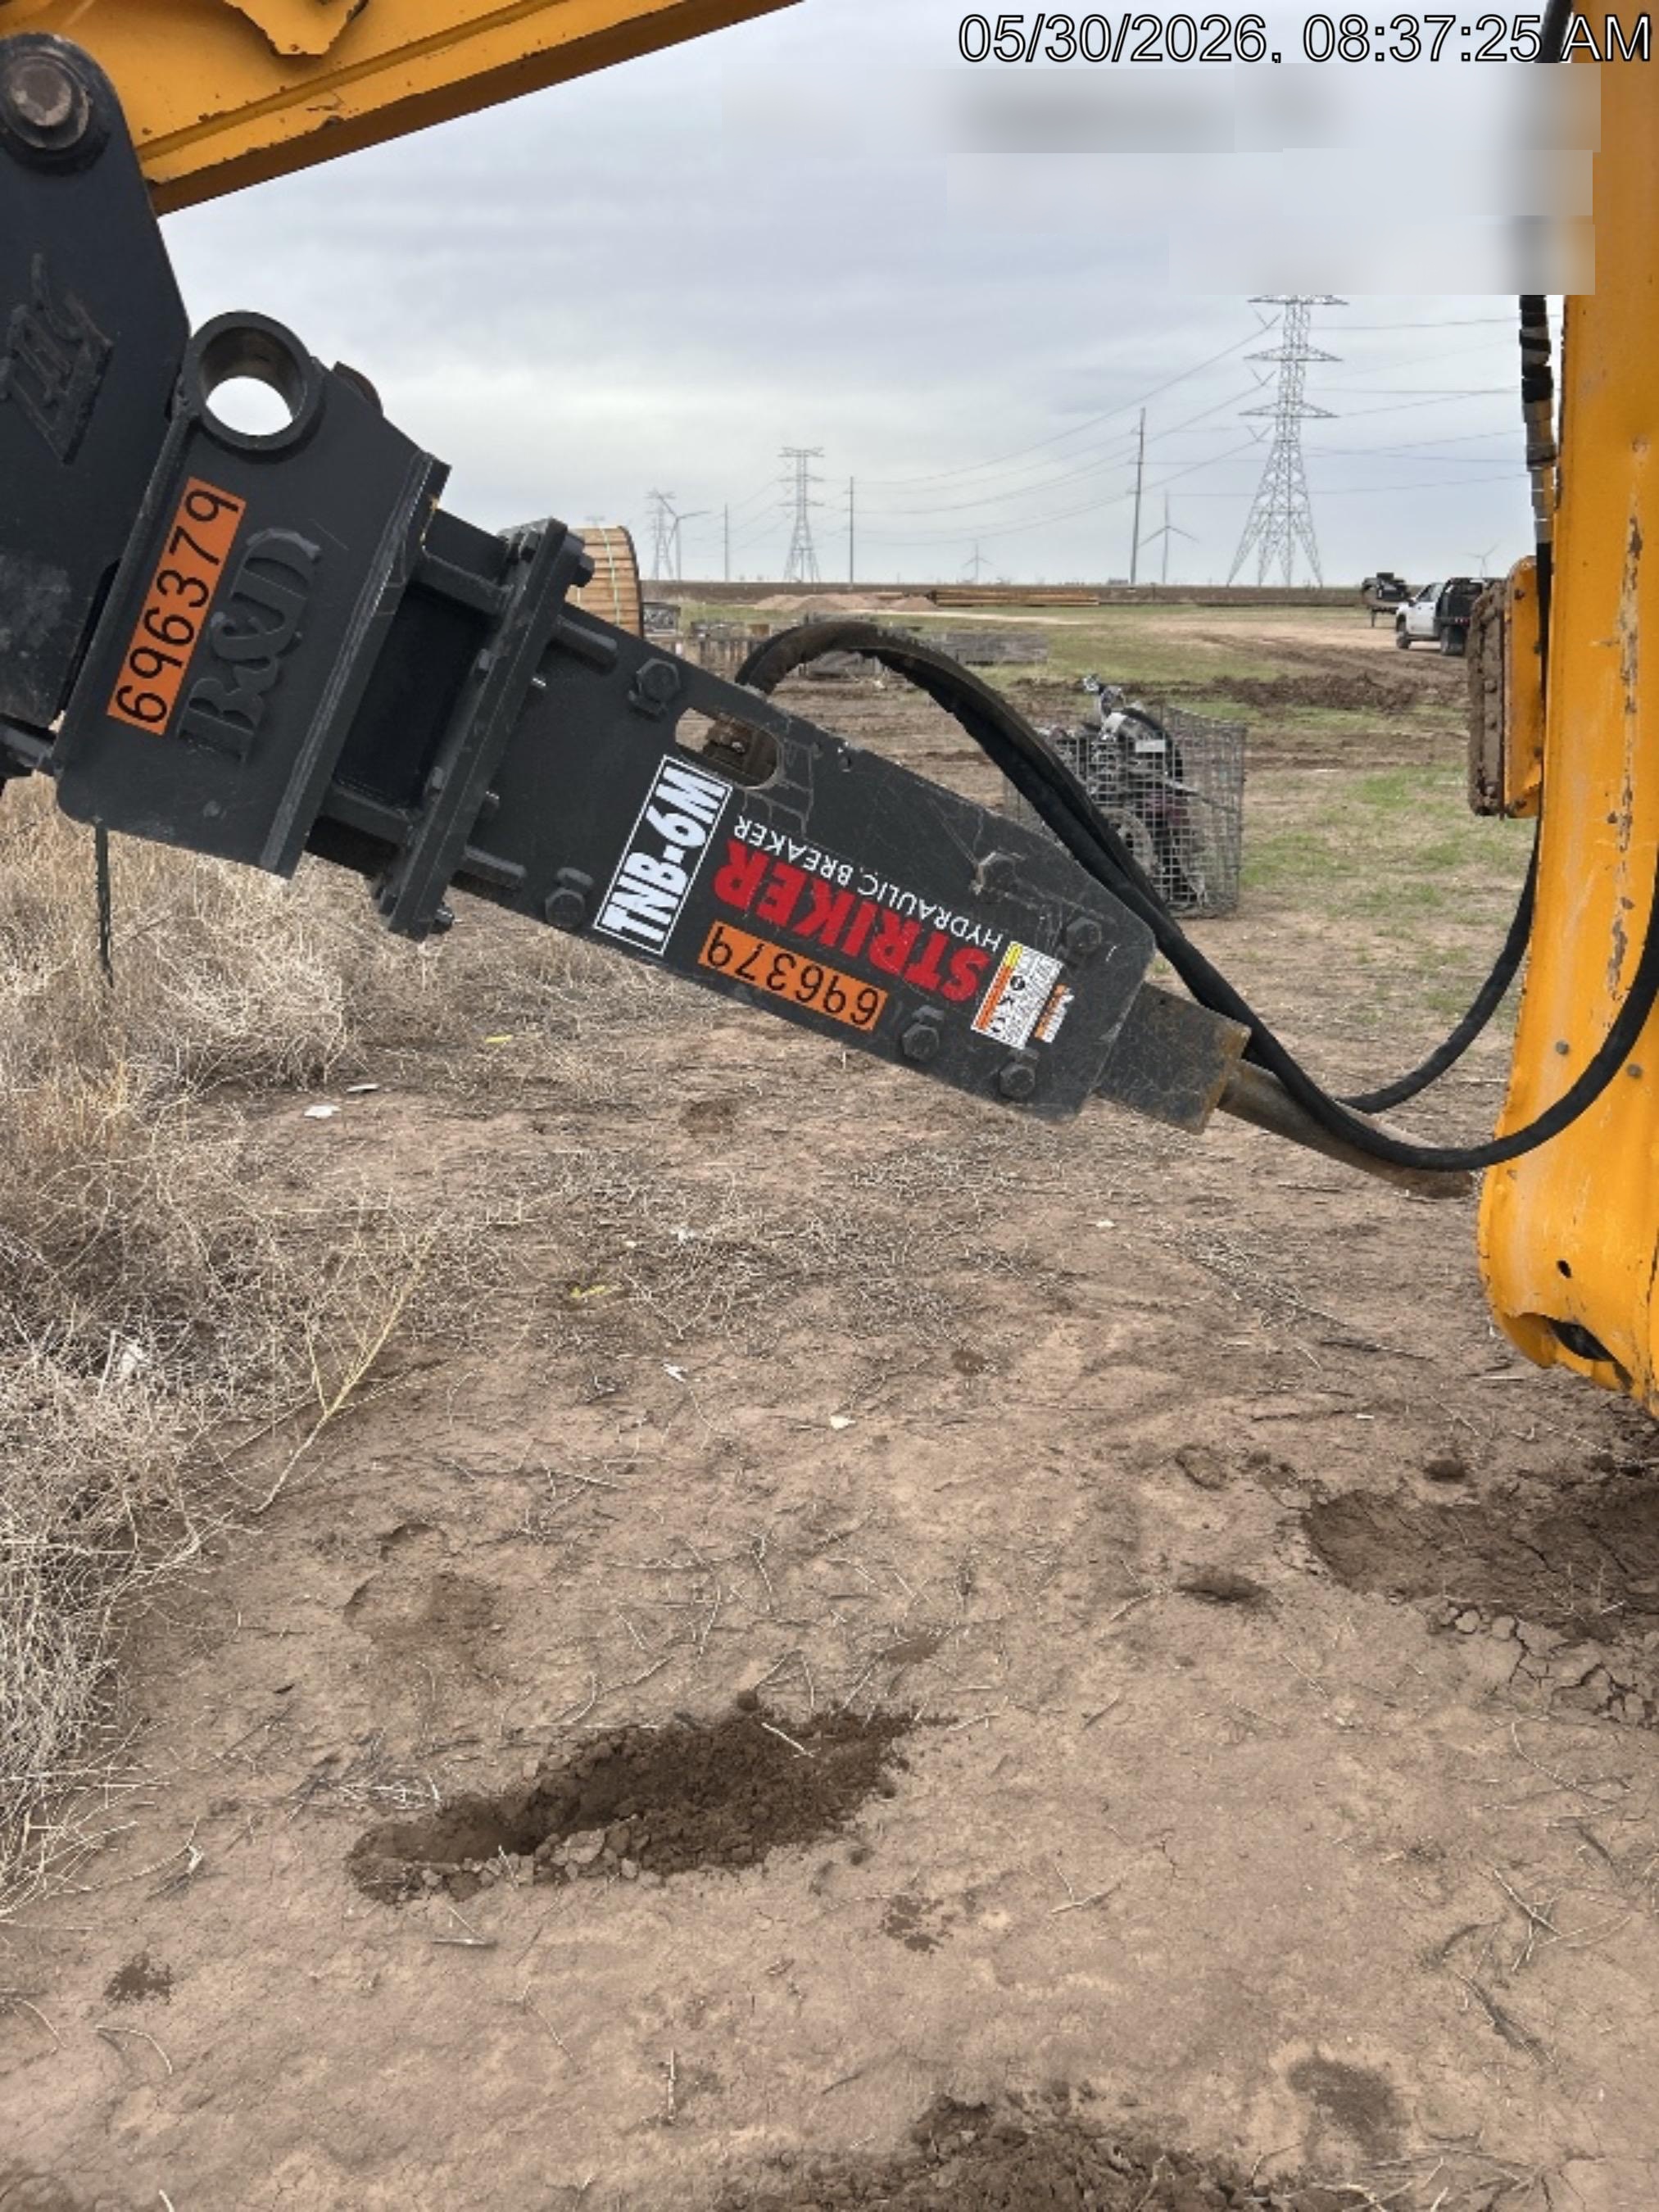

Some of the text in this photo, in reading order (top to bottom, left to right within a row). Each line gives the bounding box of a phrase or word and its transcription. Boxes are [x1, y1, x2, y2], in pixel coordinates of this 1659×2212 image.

[116, 489, 239, 723] 696379
[601, 766, 727, 942] TNB-6M
[714, 840, 990, 1001] STRIKER
[733, 815, 1004, 953] HYDRAULIC BREAKER
[708, 927, 879, 1026] 696379
